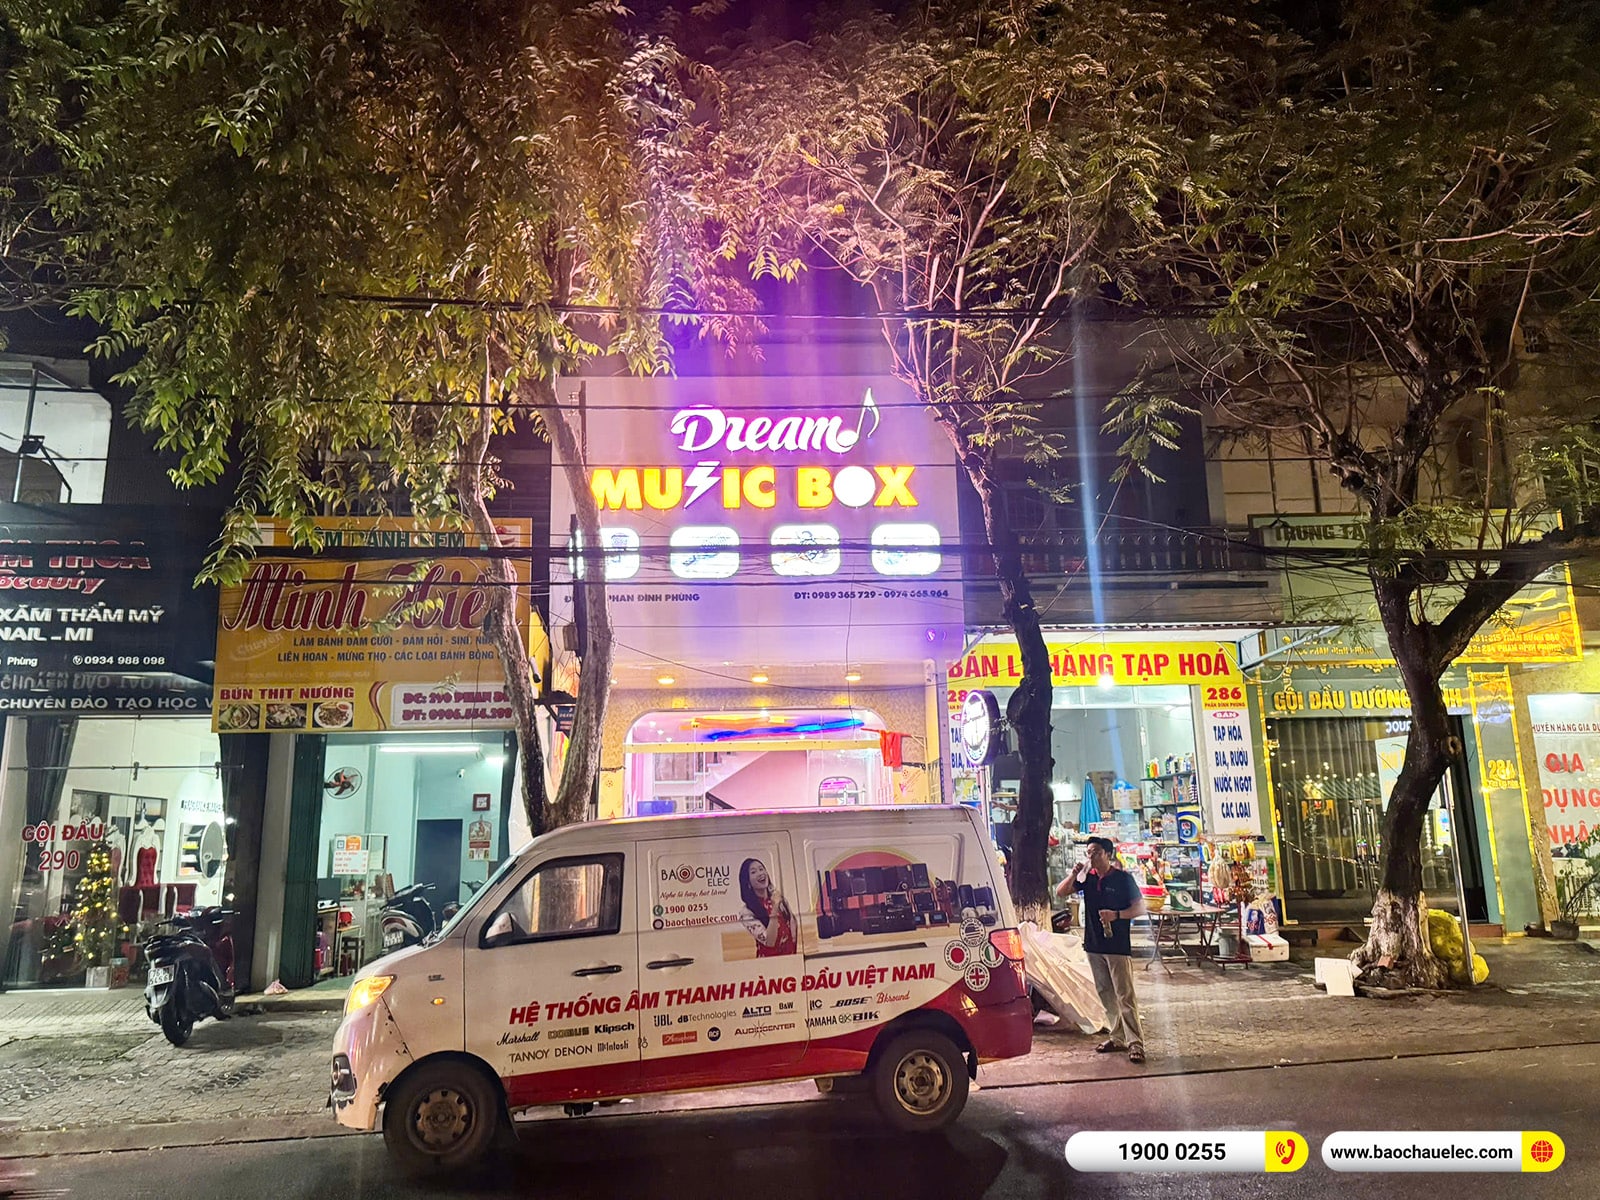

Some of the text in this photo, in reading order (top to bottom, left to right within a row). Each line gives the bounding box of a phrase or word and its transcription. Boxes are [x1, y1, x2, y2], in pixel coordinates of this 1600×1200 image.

[671, 404, 854, 453] Dream
[797, 465, 919, 509] BOX
[222, 562, 370, 632] Minh
[609, 594, 634, 603] HAN
[811, 591, 837, 600] 0989
[858, 590, 876, 598] 729
[65, 627, 94, 641] MI
[84, 655, 165, 665] 0934 988 098
[302, 652, 328, 662] HOAN
[1122, 653, 1169, 681] TẠP
[948, 690, 969, 702] 28
[1207, 687, 1242, 700] 286
[1308, 684, 1346, 710] ĐẦU
[1578, 723, 1591, 732] GIA
[1545, 753, 1585, 773] GIA
[38, 850, 80, 871] 290
[708, 878, 730, 887] ELEC
[665, 903, 708, 914] 1900 0255
[665, 914, 738, 927] baochauelec.com
[509, 1001, 541, 1028] HỆ
[544, 991, 622, 1020] THỐNG
[624, 989, 660, 1012] ÂM
[664, 980, 736, 1007] THANH
[739, 975, 797, 998] HÀNG
[801, 966, 840, 991] ĐẦU
[844, 964, 889, 989] VIỆT
[892, 963, 936, 982] NAM
[653, 1013, 673, 1028] JBL
[742, 1005, 772, 1016] ALTO
[830, 996, 872, 1008] BOSE
[805, 1015, 837, 1028] YAMAHA
[496, 1031, 540, 1047] Marshall
[594, 1021, 635, 1035] Klipsch
[554, 1044, 593, 1058] DENON
